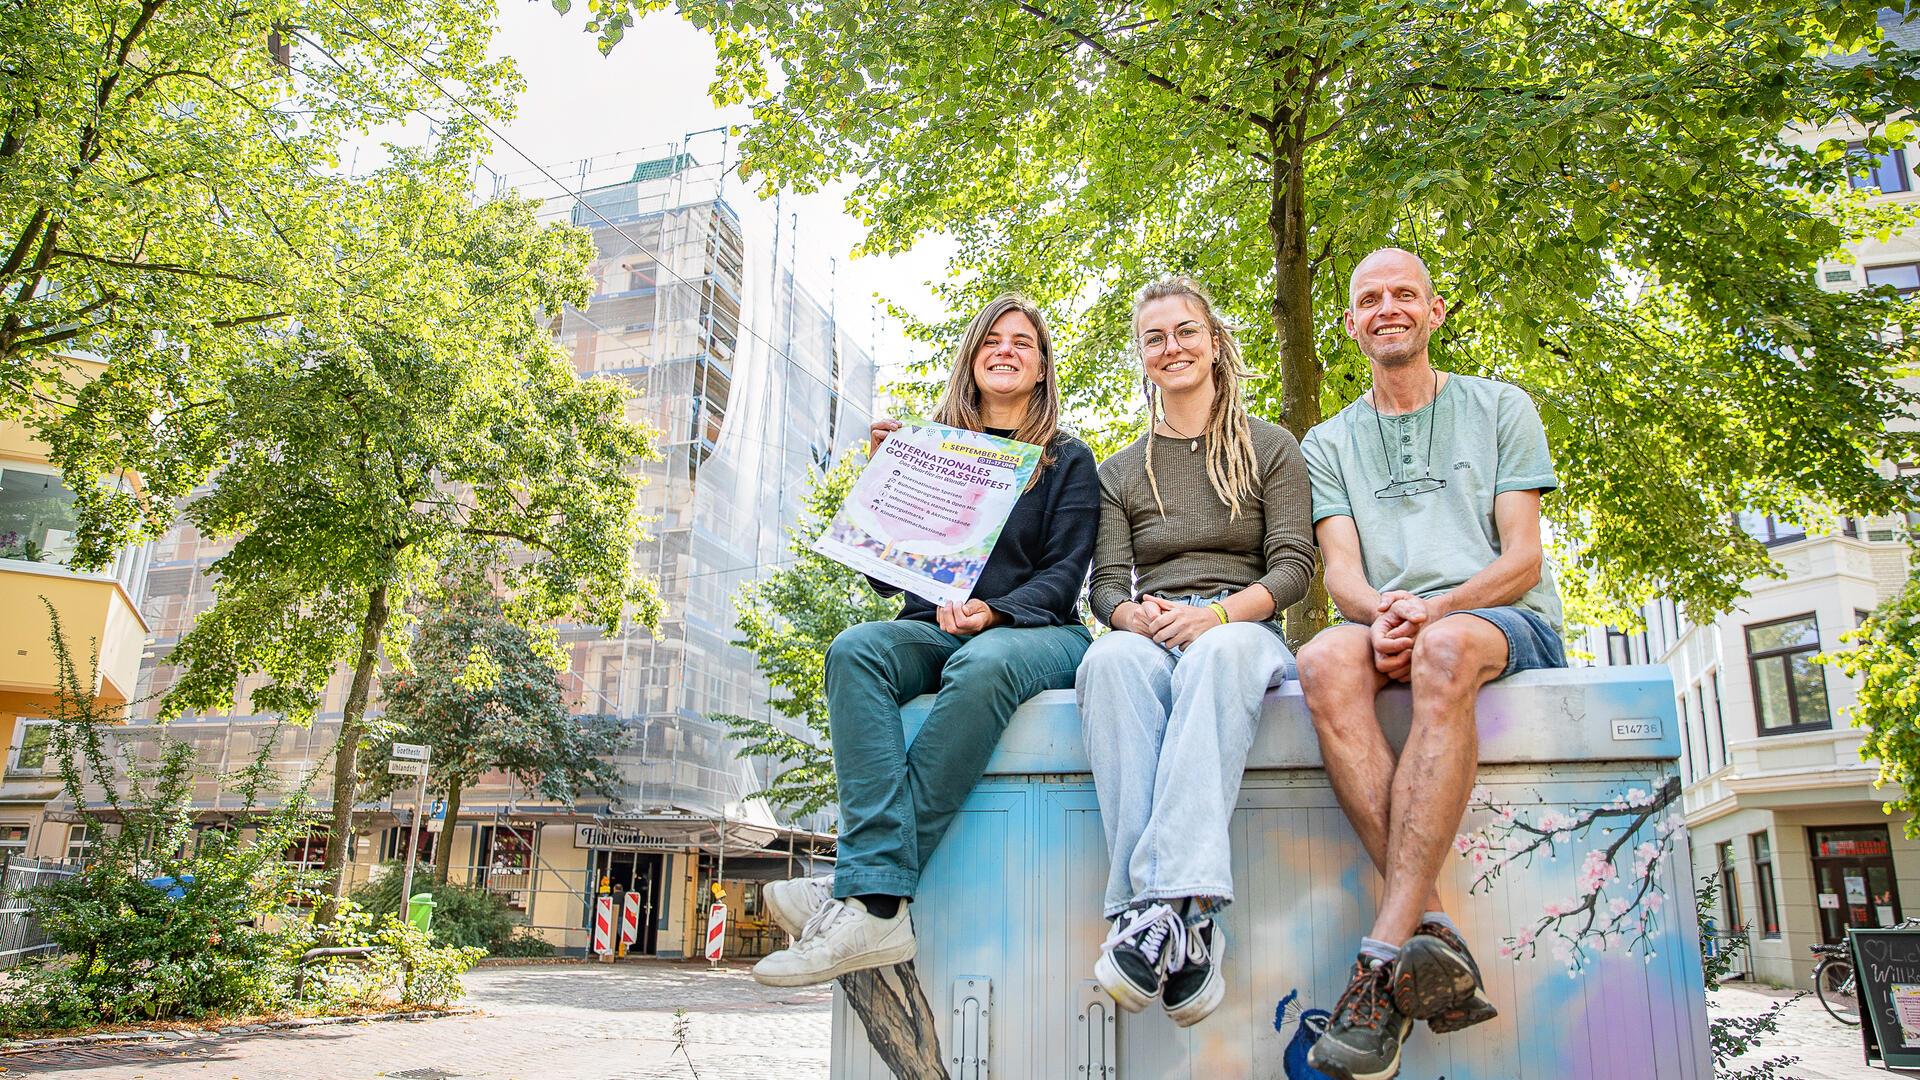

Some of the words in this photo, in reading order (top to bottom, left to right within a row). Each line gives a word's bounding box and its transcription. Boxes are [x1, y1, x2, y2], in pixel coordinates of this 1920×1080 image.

[890, 438, 991, 477] INTERNATIONALES
[950, 444, 998, 459] SEPTEMBER
[999, 454, 1020, 463] 2024
[885, 446, 1012, 491] GOETHESTRASSENFEST
[898, 459, 910, 468] Das
[910, 464, 935, 478] Quartier
[943, 477, 967, 487] Wandel
[902, 475, 941, 491] Internationale
[941, 490, 963, 499] Speisen
[885, 502, 925, 521] Sperrgutmarkt
[894, 488, 930, 505] Traditionelles
[930, 502, 959, 515] Handwerk
[880, 509, 947, 537] Kindermitmachaktionen
[1617, 723, 1658, 735] E14736
